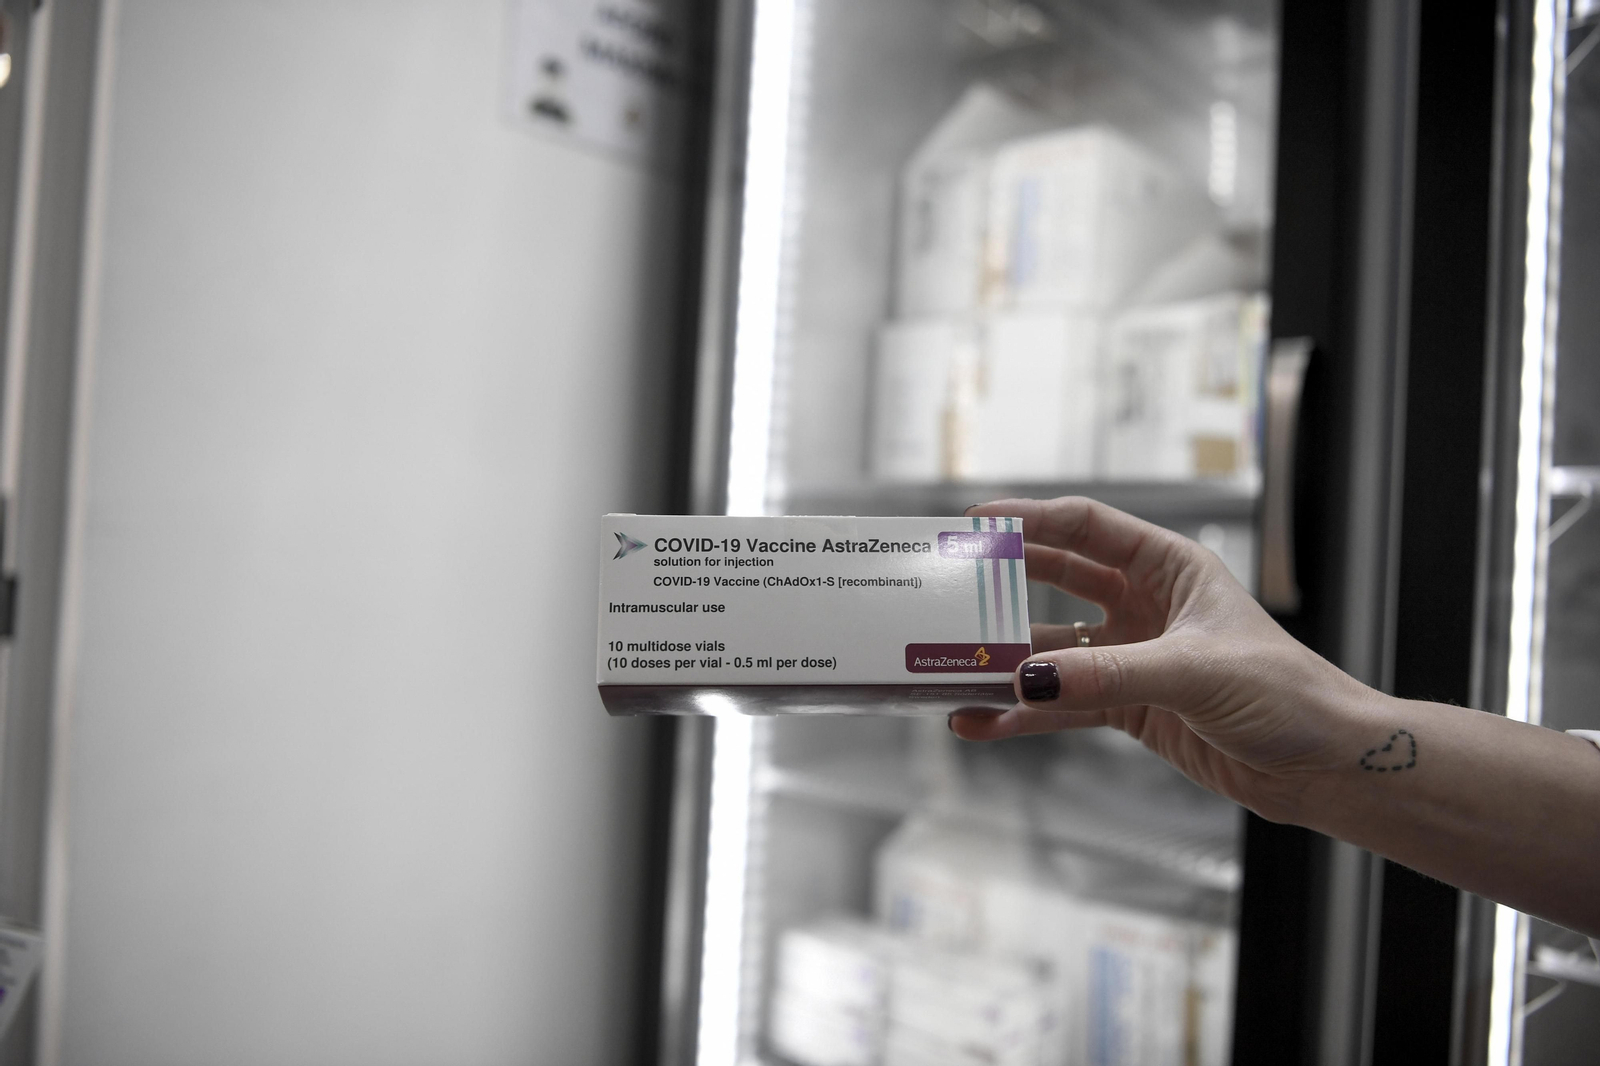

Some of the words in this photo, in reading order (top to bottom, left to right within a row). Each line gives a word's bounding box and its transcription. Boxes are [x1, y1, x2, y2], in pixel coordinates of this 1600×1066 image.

[654, 538, 741, 553] COVID-19
[746, 538, 816, 553] Vaccine
[821, 538, 931, 553] AstraZeneca
[946, 535, 960, 553] 5
[964, 540, 983, 553] ml
[653, 557, 701, 567] solution
[705, 557, 721, 567] for
[724, 557, 774, 569] injection
[653, 576, 710, 587] COVID-19
[713, 576, 760, 587] Vaccine
[763, 576, 835, 588] (ChAdOx1-S
[838, 576, 922, 589] [recombinant])
[609, 602, 699, 613] Intramuscular
[702, 604, 726, 613] use
[608, 641, 623, 652] 10
[627, 641, 692, 652] multidose
[695, 641, 726, 652] vials
[607, 657, 628, 671] (10
[631, 657, 671, 669] doses
[674, 659, 696, 671] per
[699, 657, 722, 669] vial
[734, 657, 753, 668] 0.5
[757, 657, 773, 668] ml
[776, 659, 798, 671] per
[801, 656, 837, 670] dose)
[914, 657, 977, 667] AstraZeneca
